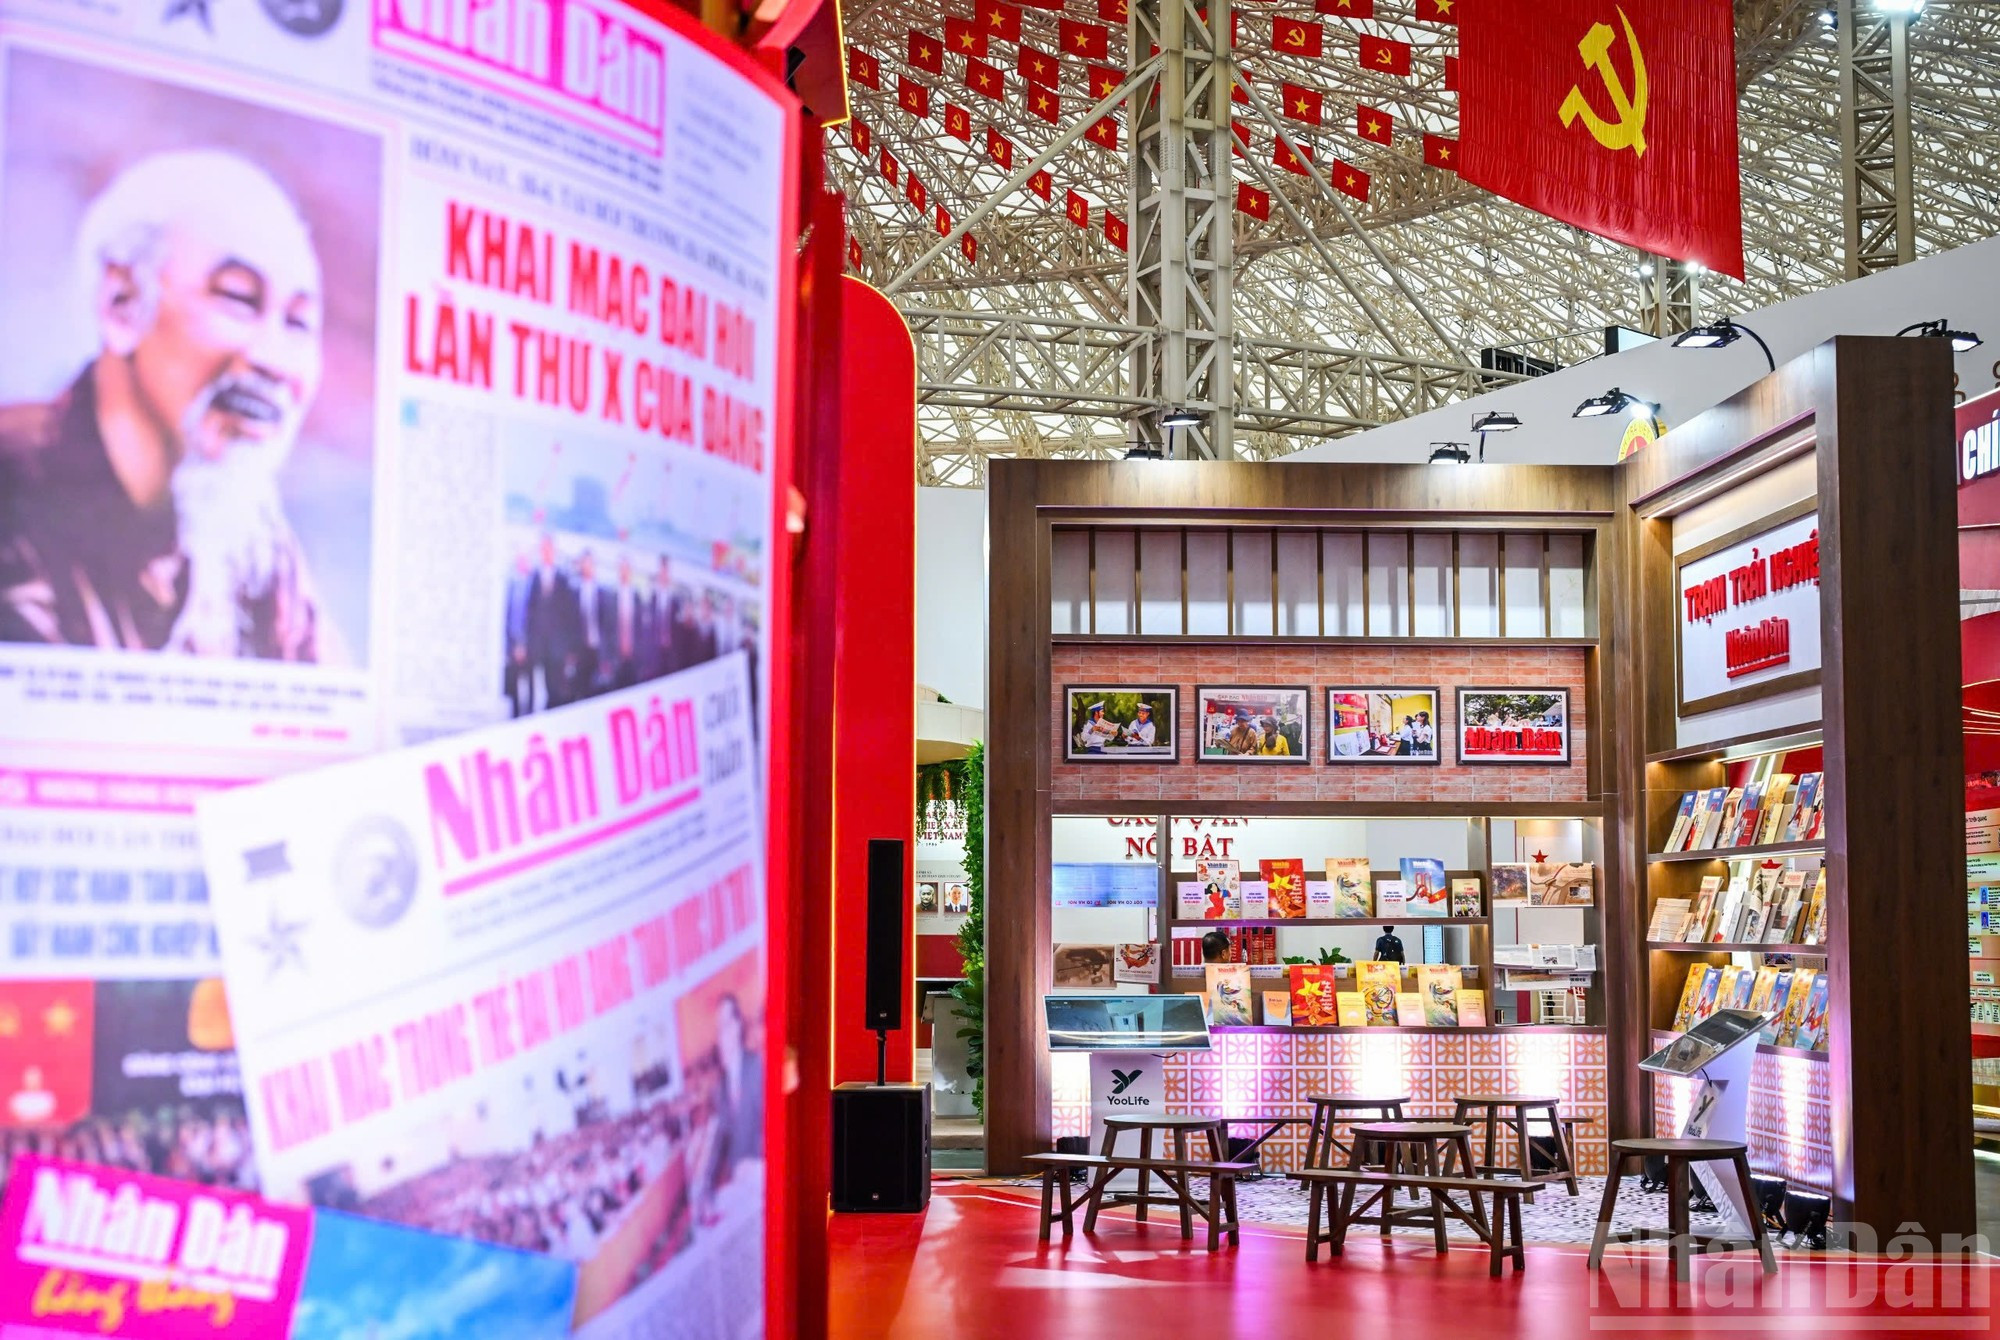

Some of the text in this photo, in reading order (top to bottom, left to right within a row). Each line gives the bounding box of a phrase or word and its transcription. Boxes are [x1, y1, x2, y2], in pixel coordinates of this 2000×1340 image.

[562, 2, 661, 131] Dân
[447, 200, 555, 305] KHAI
[602, 346, 625, 424] X
[1684, 573, 1727, 624] TRẠM
[1729, 548, 1766, 606] TRẢI
[1465, 727, 1561, 750] Nhân Dân
[424, 730, 600, 868] Nhân
[608, 694, 699, 806] Dân
[1183, 833, 1234, 861] BẬT
[1107, 1095, 1150, 1106] YooLife
[22, 1167, 290, 1282] Nhân Dân
